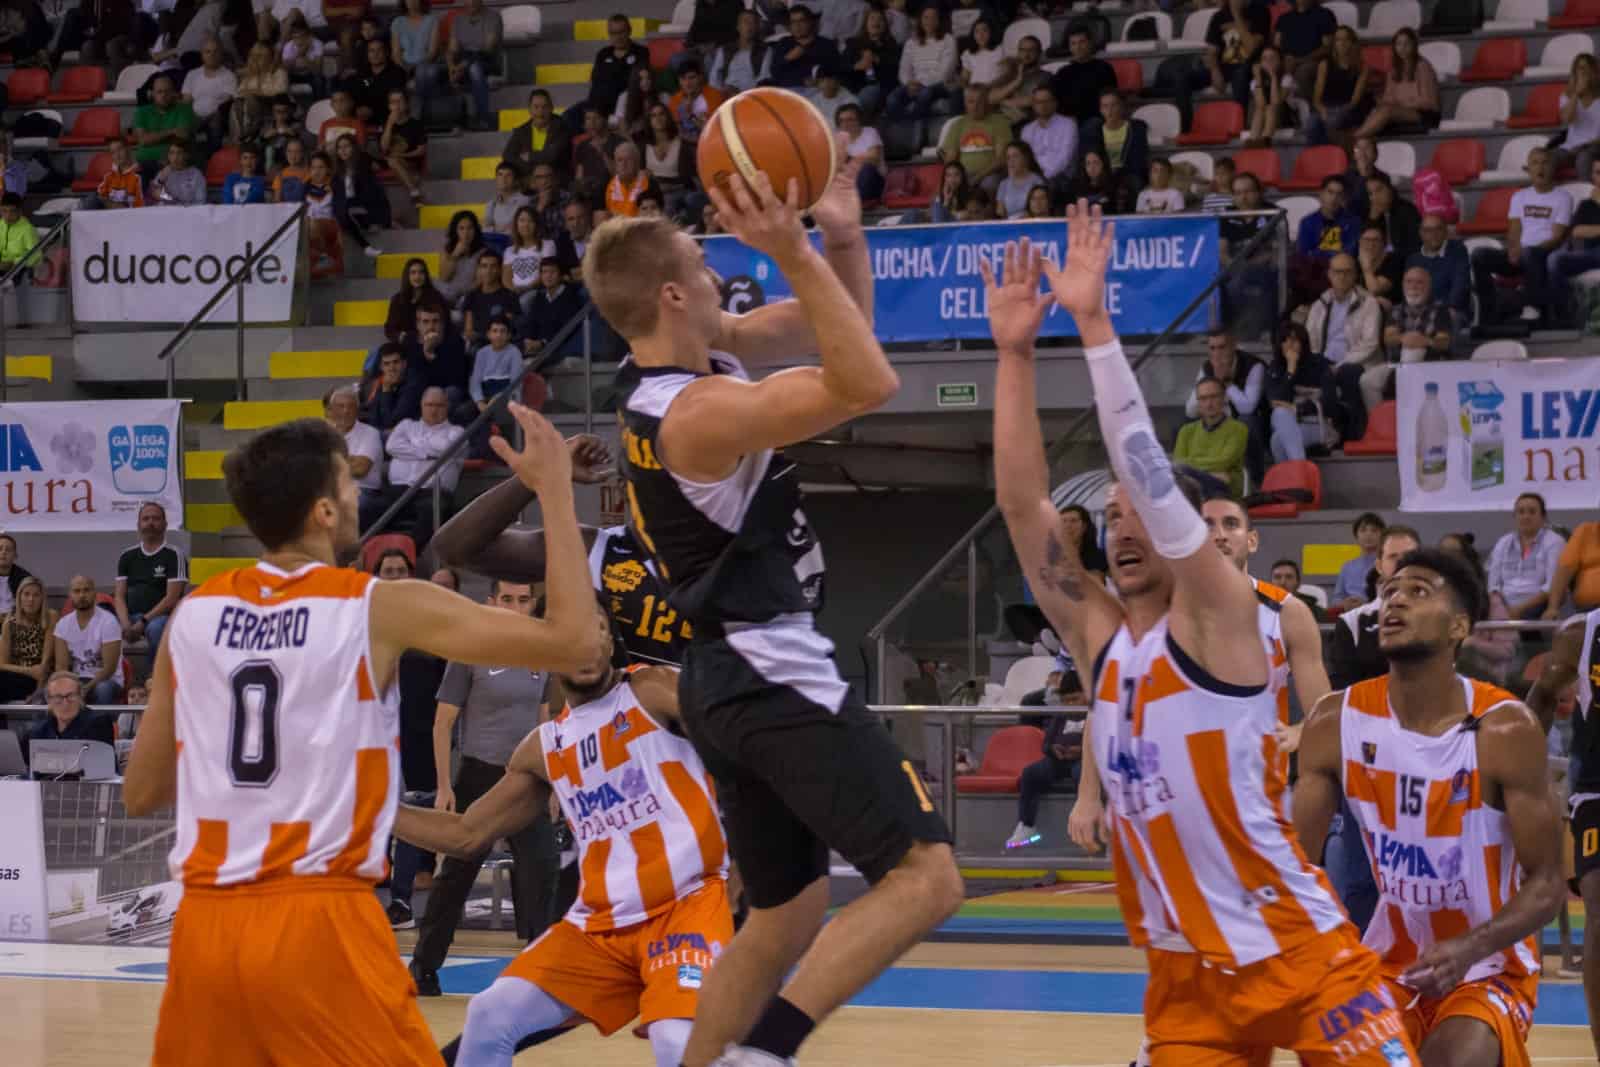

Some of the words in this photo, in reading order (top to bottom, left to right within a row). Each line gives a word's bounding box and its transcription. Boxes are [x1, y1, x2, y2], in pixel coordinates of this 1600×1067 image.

[83, 241, 287, 284] duacode.
[872, 248, 934, 279] UCHA
[214, 605, 309, 651] FERREIRO
[636, 595, 677, 643] 12
[226, 658, 284, 789] 0
[580, 732, 598, 769] 10
[1400, 773, 1426, 817] 15
